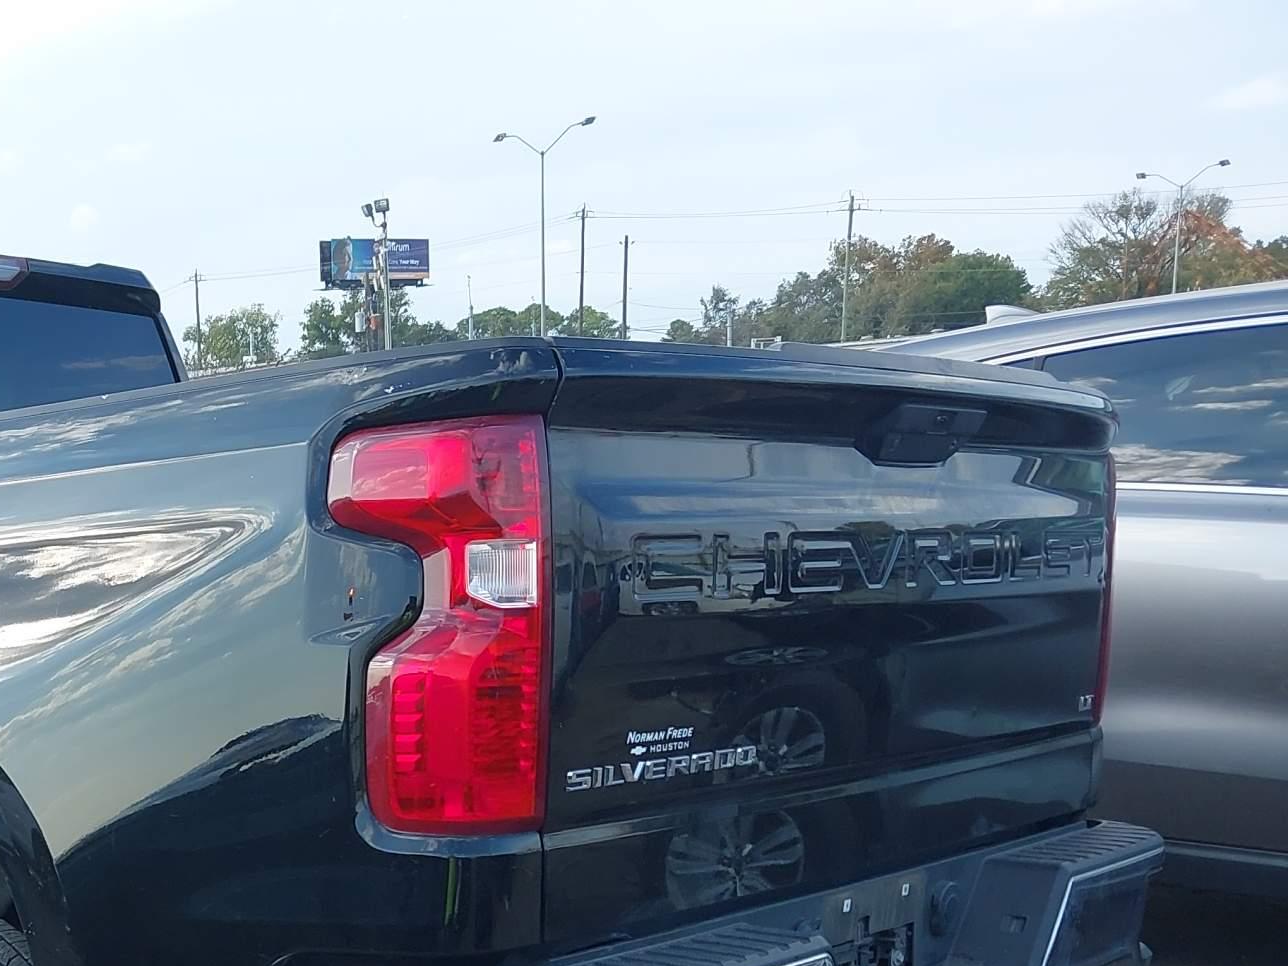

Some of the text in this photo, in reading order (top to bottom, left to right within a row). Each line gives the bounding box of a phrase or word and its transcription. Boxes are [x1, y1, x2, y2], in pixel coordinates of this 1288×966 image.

[631, 528, 1103, 599] CHEVROLET
[626, 727, 695, 745] NORMAN FREDE
[649, 741, 690, 753] HOUSTON
[565, 745, 757, 791] SILVERADO
